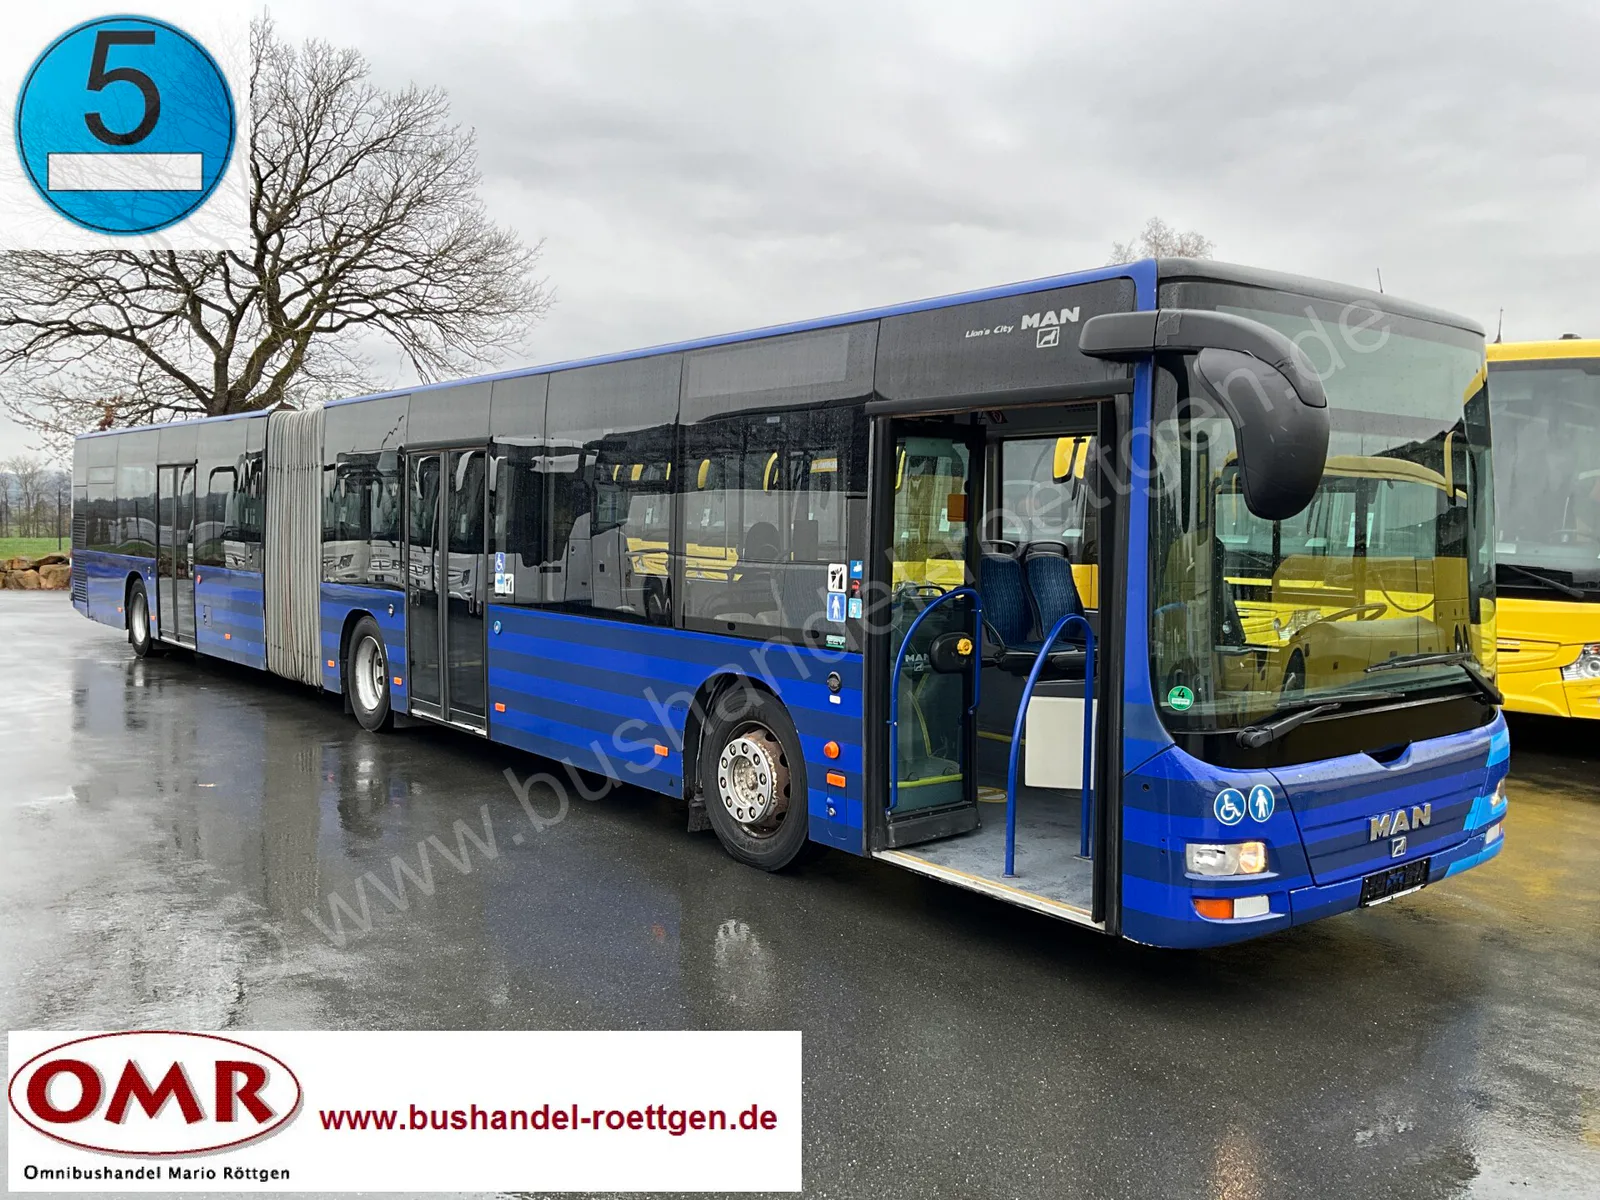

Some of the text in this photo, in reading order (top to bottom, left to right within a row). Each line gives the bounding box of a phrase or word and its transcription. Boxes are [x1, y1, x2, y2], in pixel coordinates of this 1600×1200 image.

[1021, 306, 1080, 330] MAN
[965, 325, 1014, 339] Lion's City
[1178, 687, 1185, 698] 4
[1370, 803, 1431, 841] MAN
